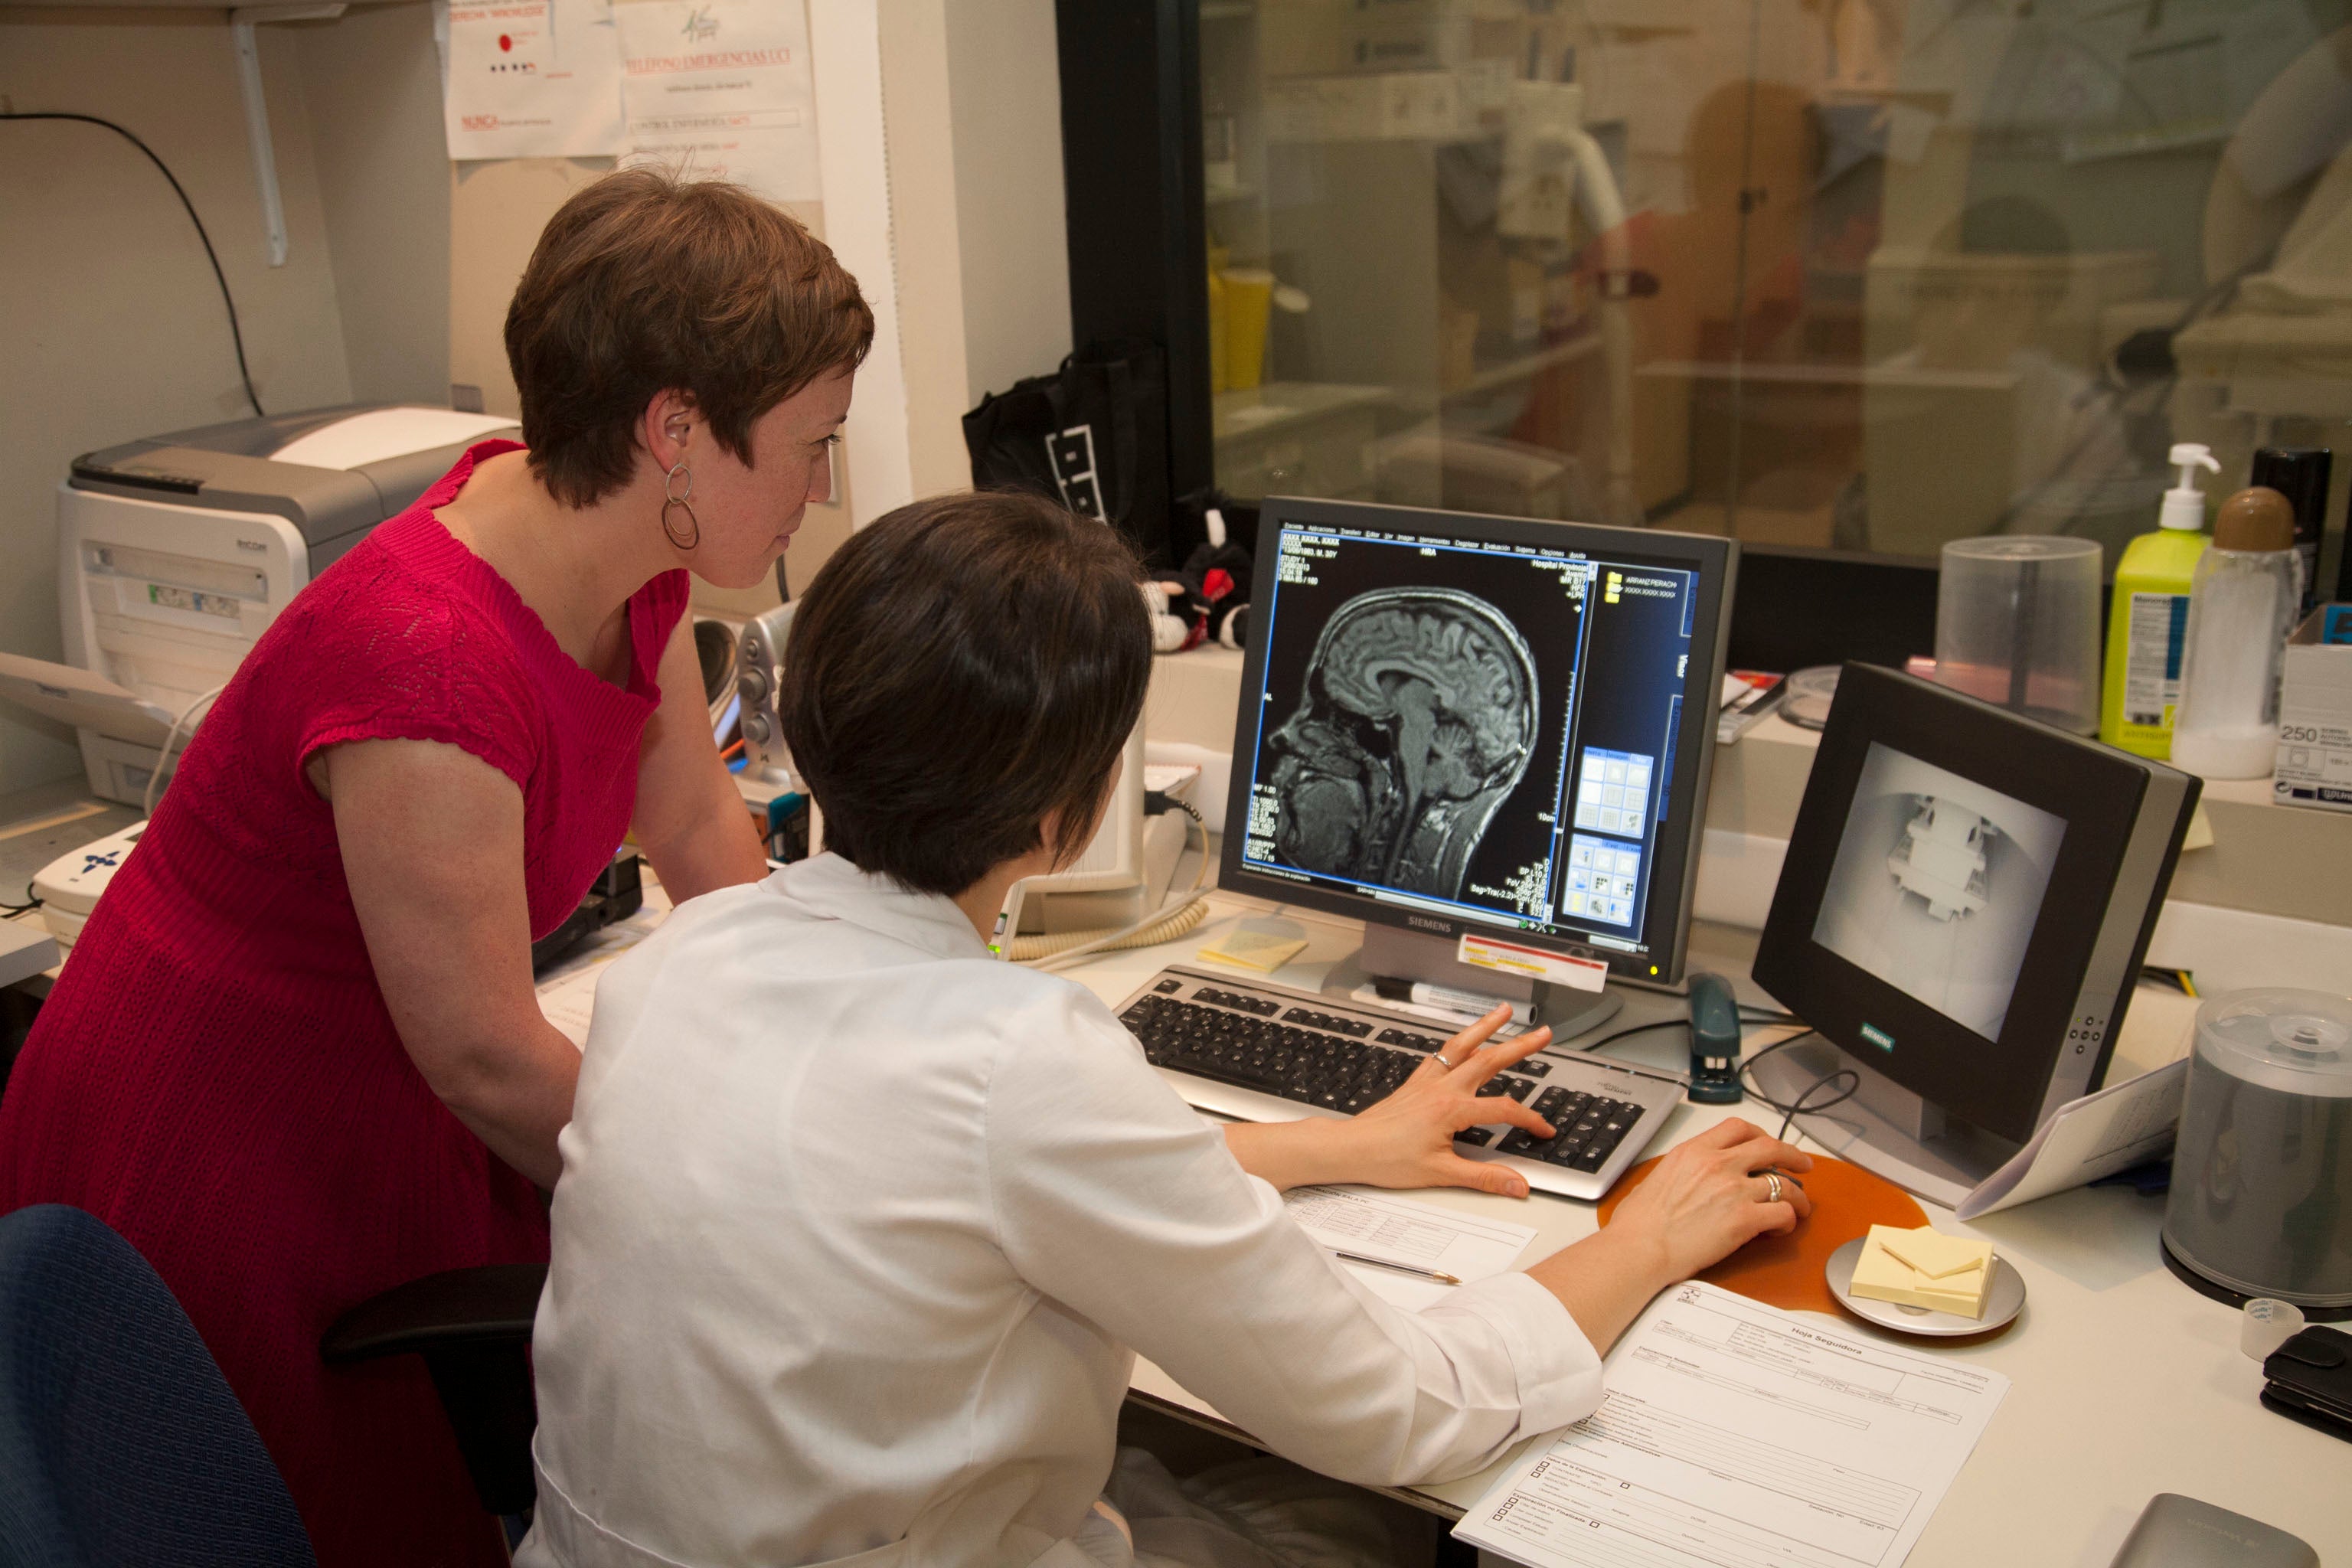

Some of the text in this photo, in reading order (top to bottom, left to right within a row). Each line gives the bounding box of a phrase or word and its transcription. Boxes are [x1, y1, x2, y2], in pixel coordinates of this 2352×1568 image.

[1532, 560, 1588, 572] Hospital Provincial
[2281, 726, 2318, 743] 250
[1409, 916, 1452, 933] SIEMENS
[1863, 1027, 1892, 1048] SIEMENS
[1791, 1327, 1813, 1339] Hoja
[1815, 1335, 1863, 1355] Seguidora
[1546, 1455, 1561, 1465] Datos
[1512, 1492, 1547, 1509] Exploración
[1557, 1508, 1587, 1524] Finalizada:
